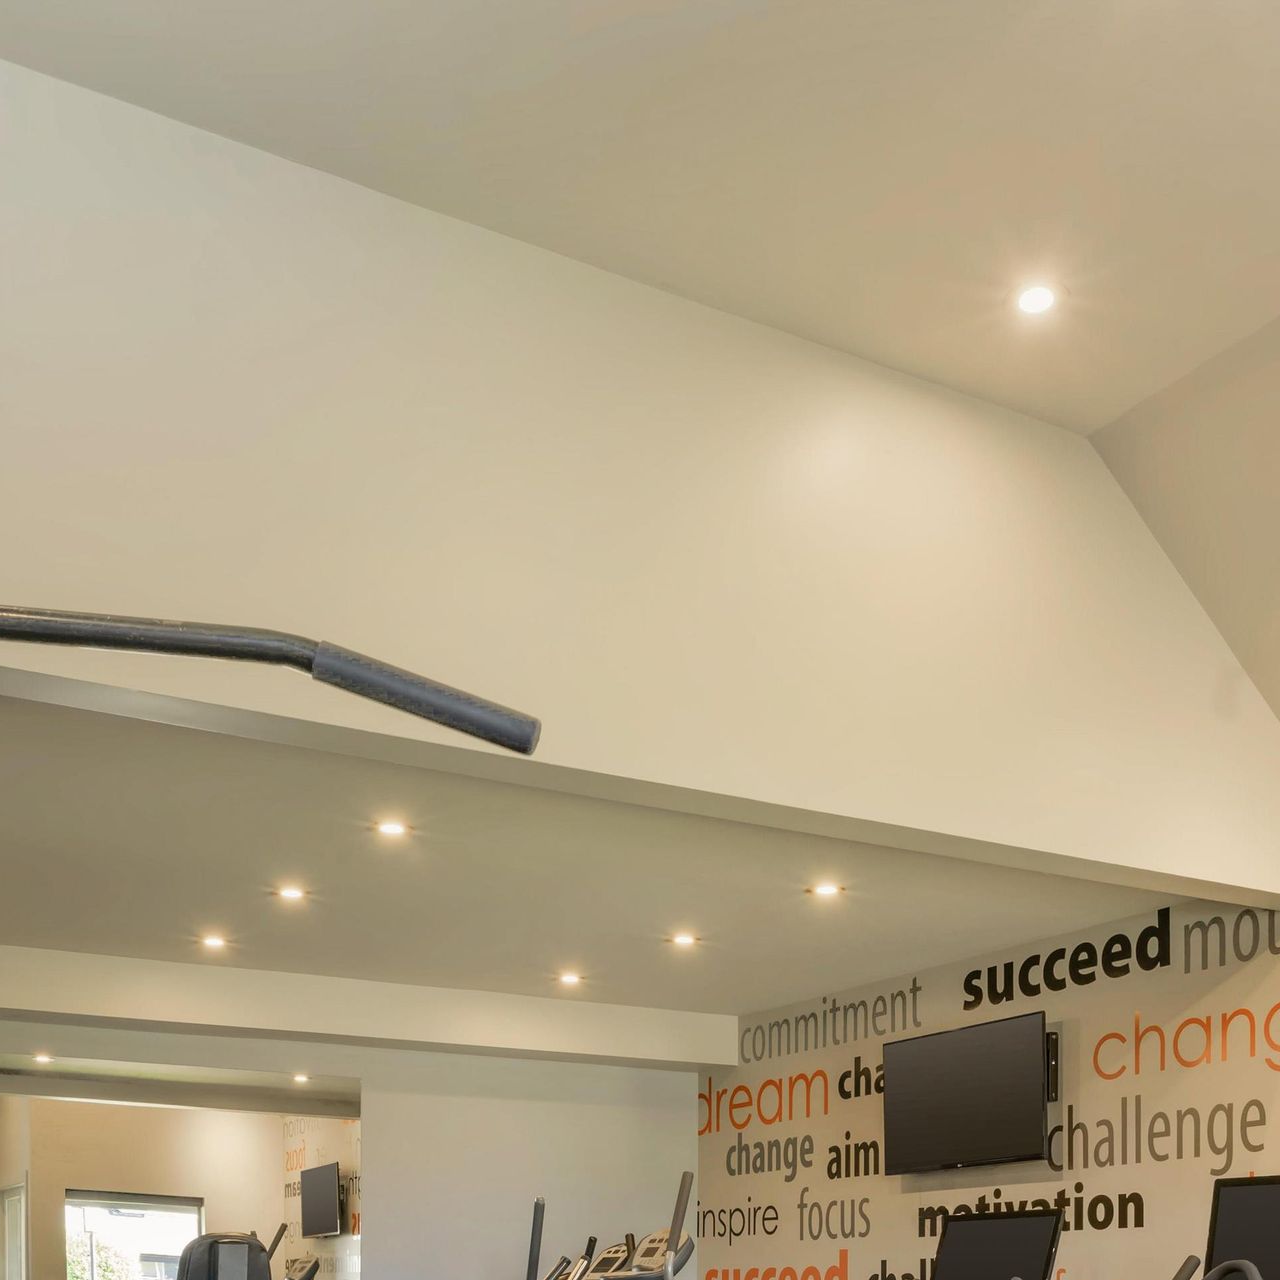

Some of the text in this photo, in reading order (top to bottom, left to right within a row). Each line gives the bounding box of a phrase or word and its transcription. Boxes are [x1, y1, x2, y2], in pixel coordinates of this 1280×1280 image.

[963, 908, 1172, 1011] succeed
[740, 976, 922, 1063] commitment
[698, 1068, 828, 1135] dream
[726, 1133, 814, 1182] change
[827, 1131, 880, 1179] aim
[1047, 1094, 1267, 1177] challenge
[697, 1196, 778, 1246] inspire
[797, 1187, 870, 1240] focus
